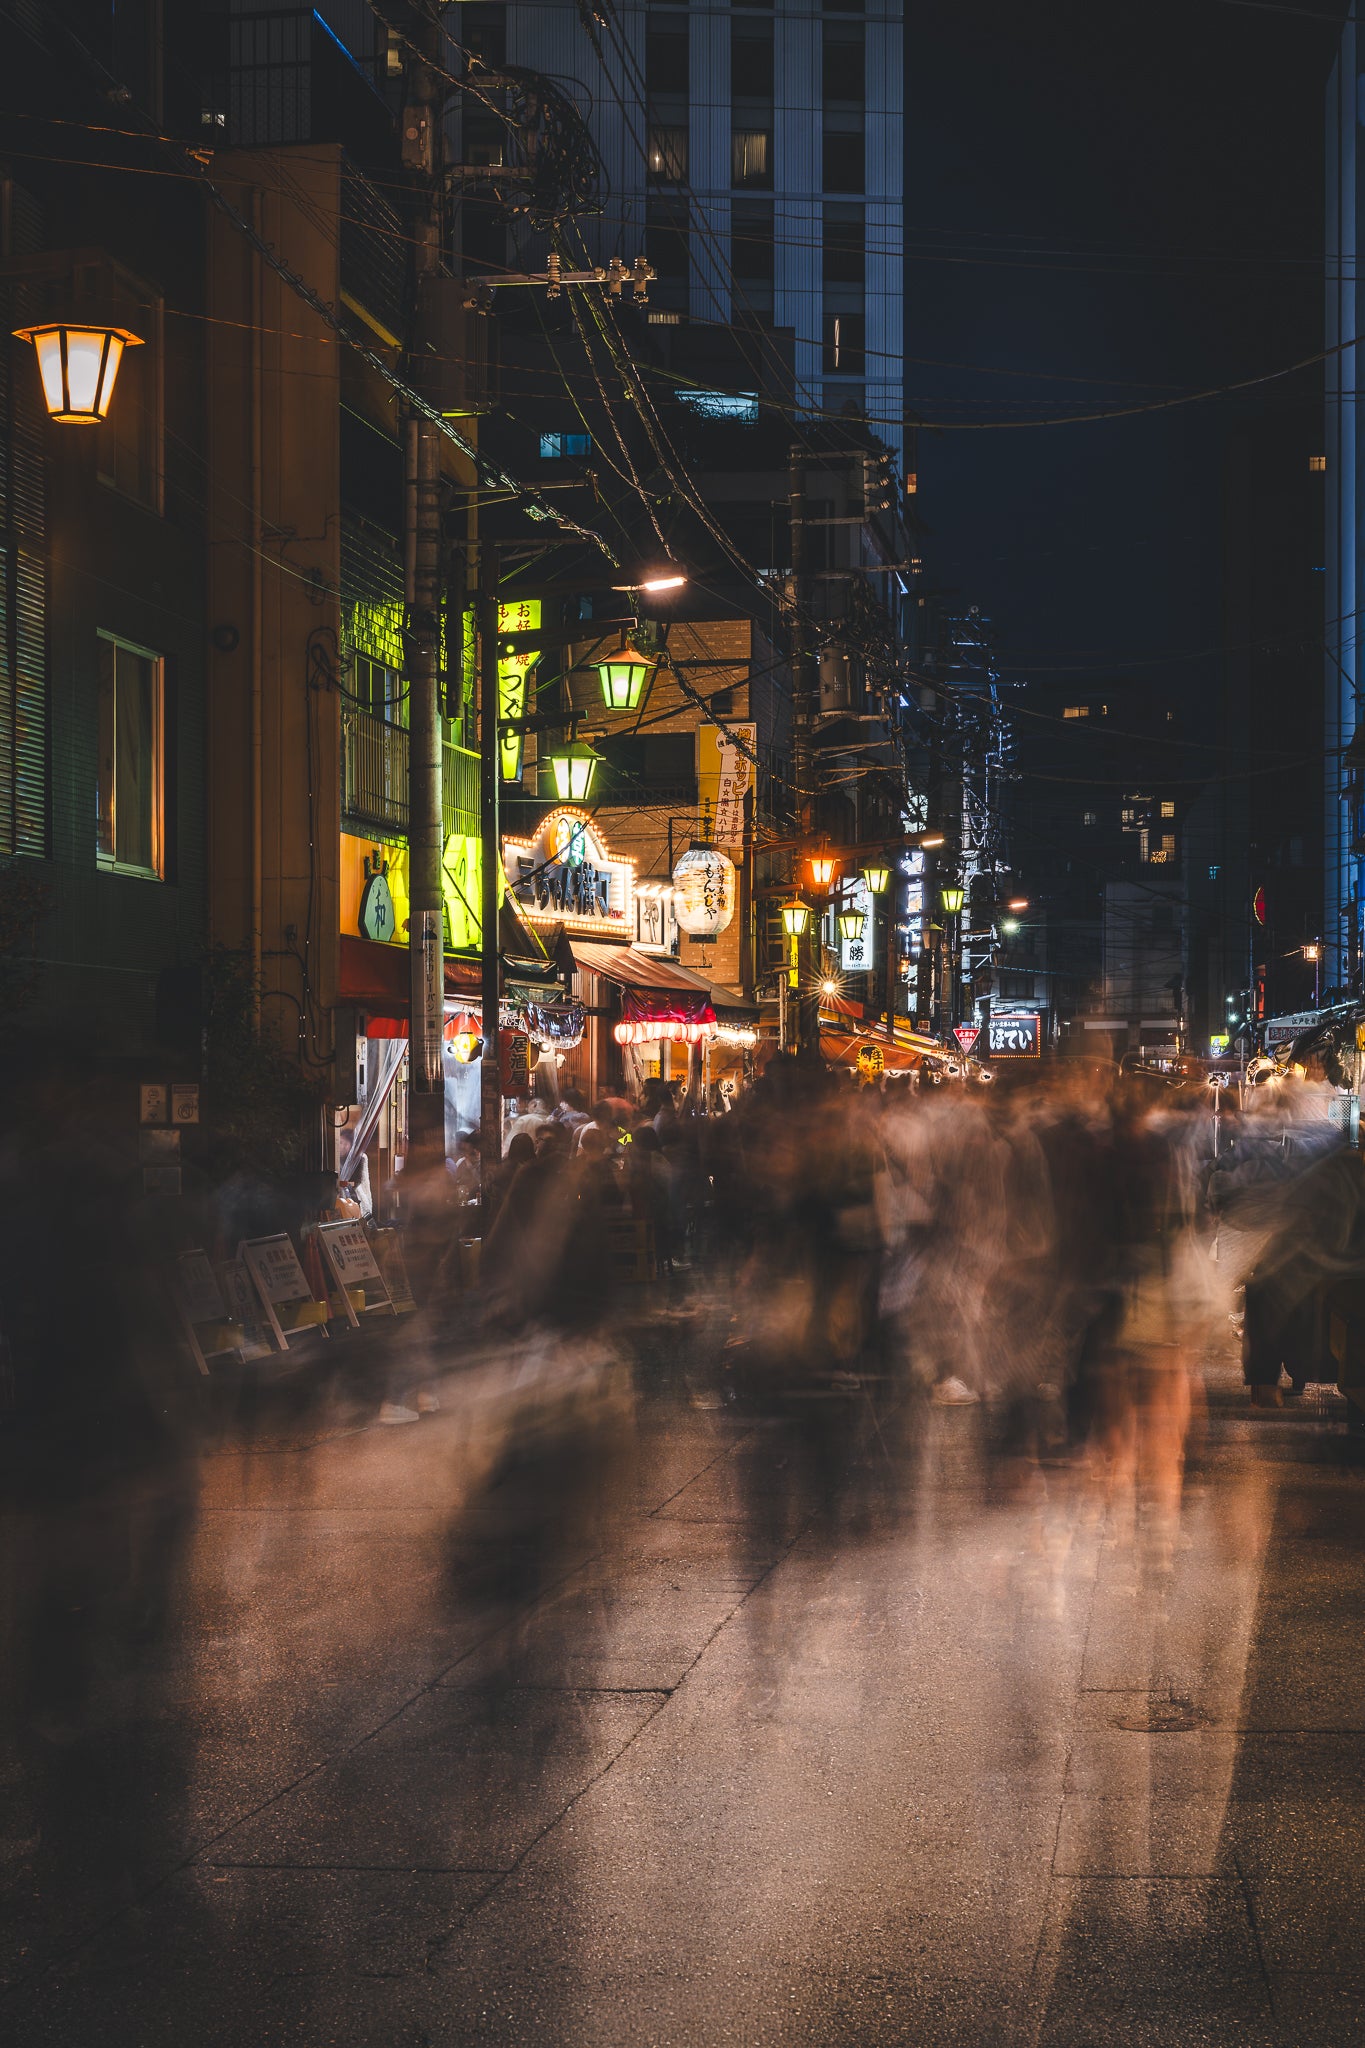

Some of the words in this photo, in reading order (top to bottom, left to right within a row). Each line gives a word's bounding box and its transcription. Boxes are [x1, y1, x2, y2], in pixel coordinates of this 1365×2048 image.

[516, 603, 531, 666] お好焼
[507, 1036, 528, 1087] 居酒屋
